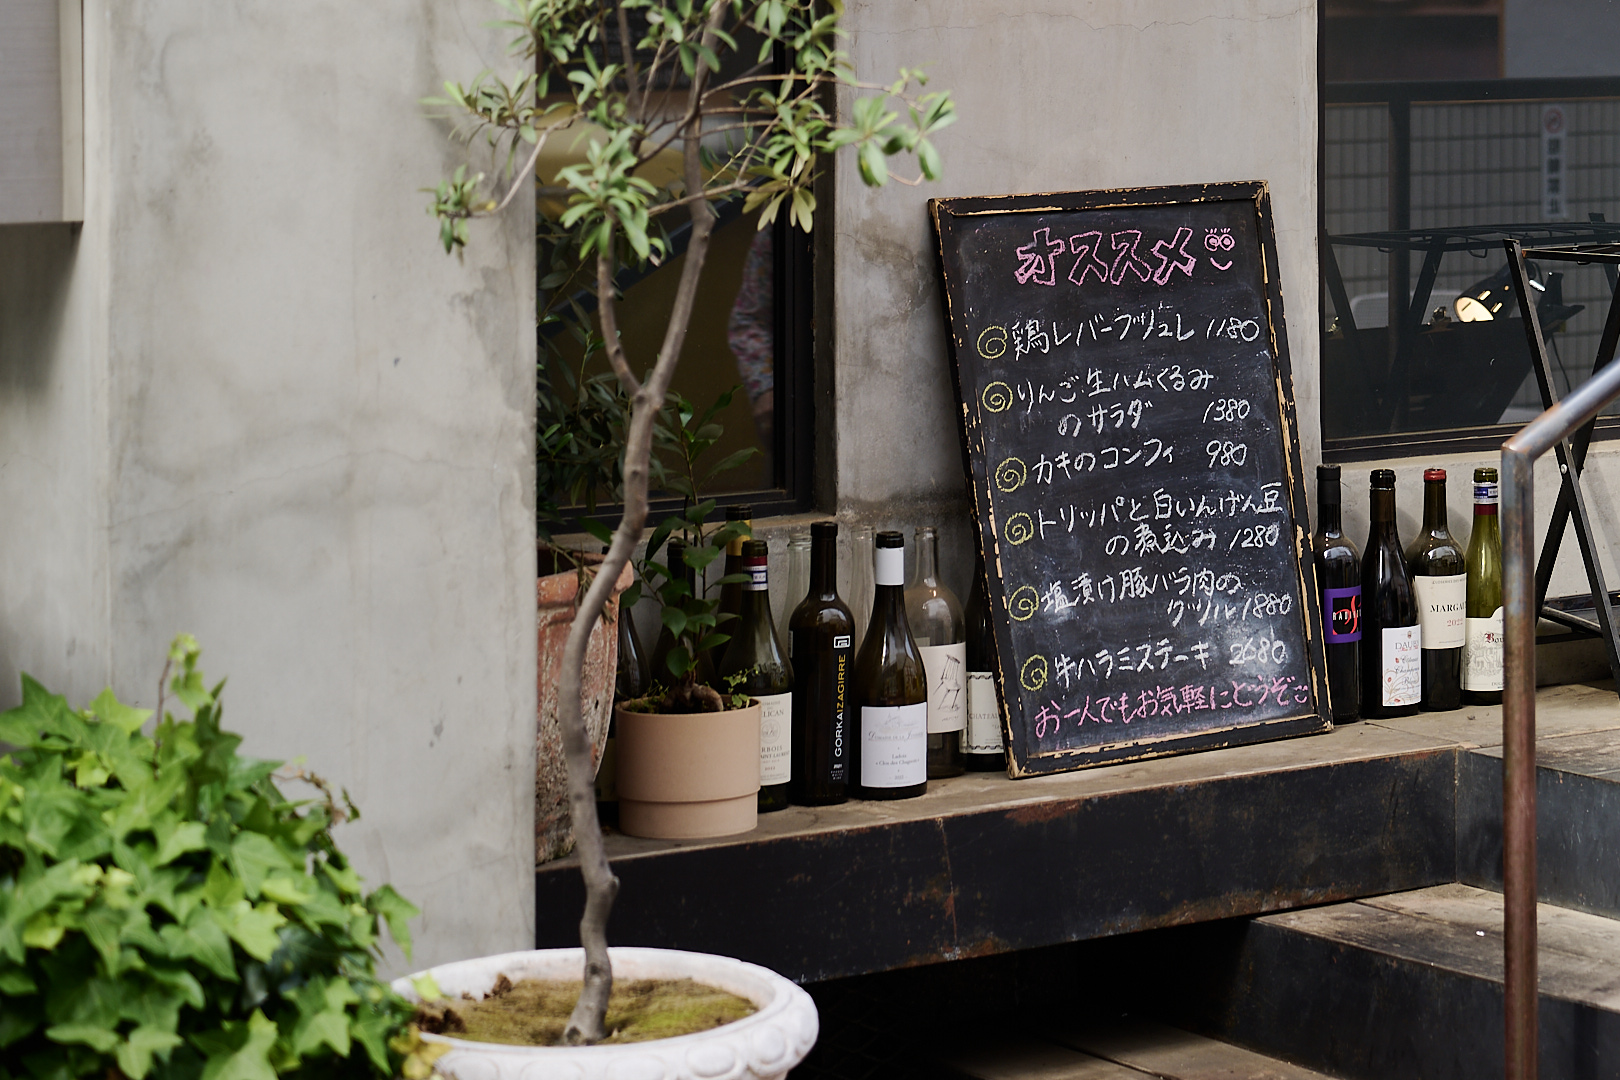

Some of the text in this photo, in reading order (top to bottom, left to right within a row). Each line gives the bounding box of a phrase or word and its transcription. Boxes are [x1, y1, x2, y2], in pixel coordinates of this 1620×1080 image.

[1014, 226, 1197, 286] オススメ
[1206, 317, 1260, 342] 1180
[1057, 398, 1251, 438] のサラダ 1380
[1031, 439, 1249, 486] カキのコンフィ 980
[1037, 482, 1284, 540] トリッパと白いんげん豆
[1105, 524, 1281, 557] の煮込み 1280
[1241, 593, 1294, 622] 1880
[1054, 638, 1210, 689] 牛ハラミステーキ
[761, 709, 785, 718] LICAN
[761, 745, 783, 753] RBOIS
